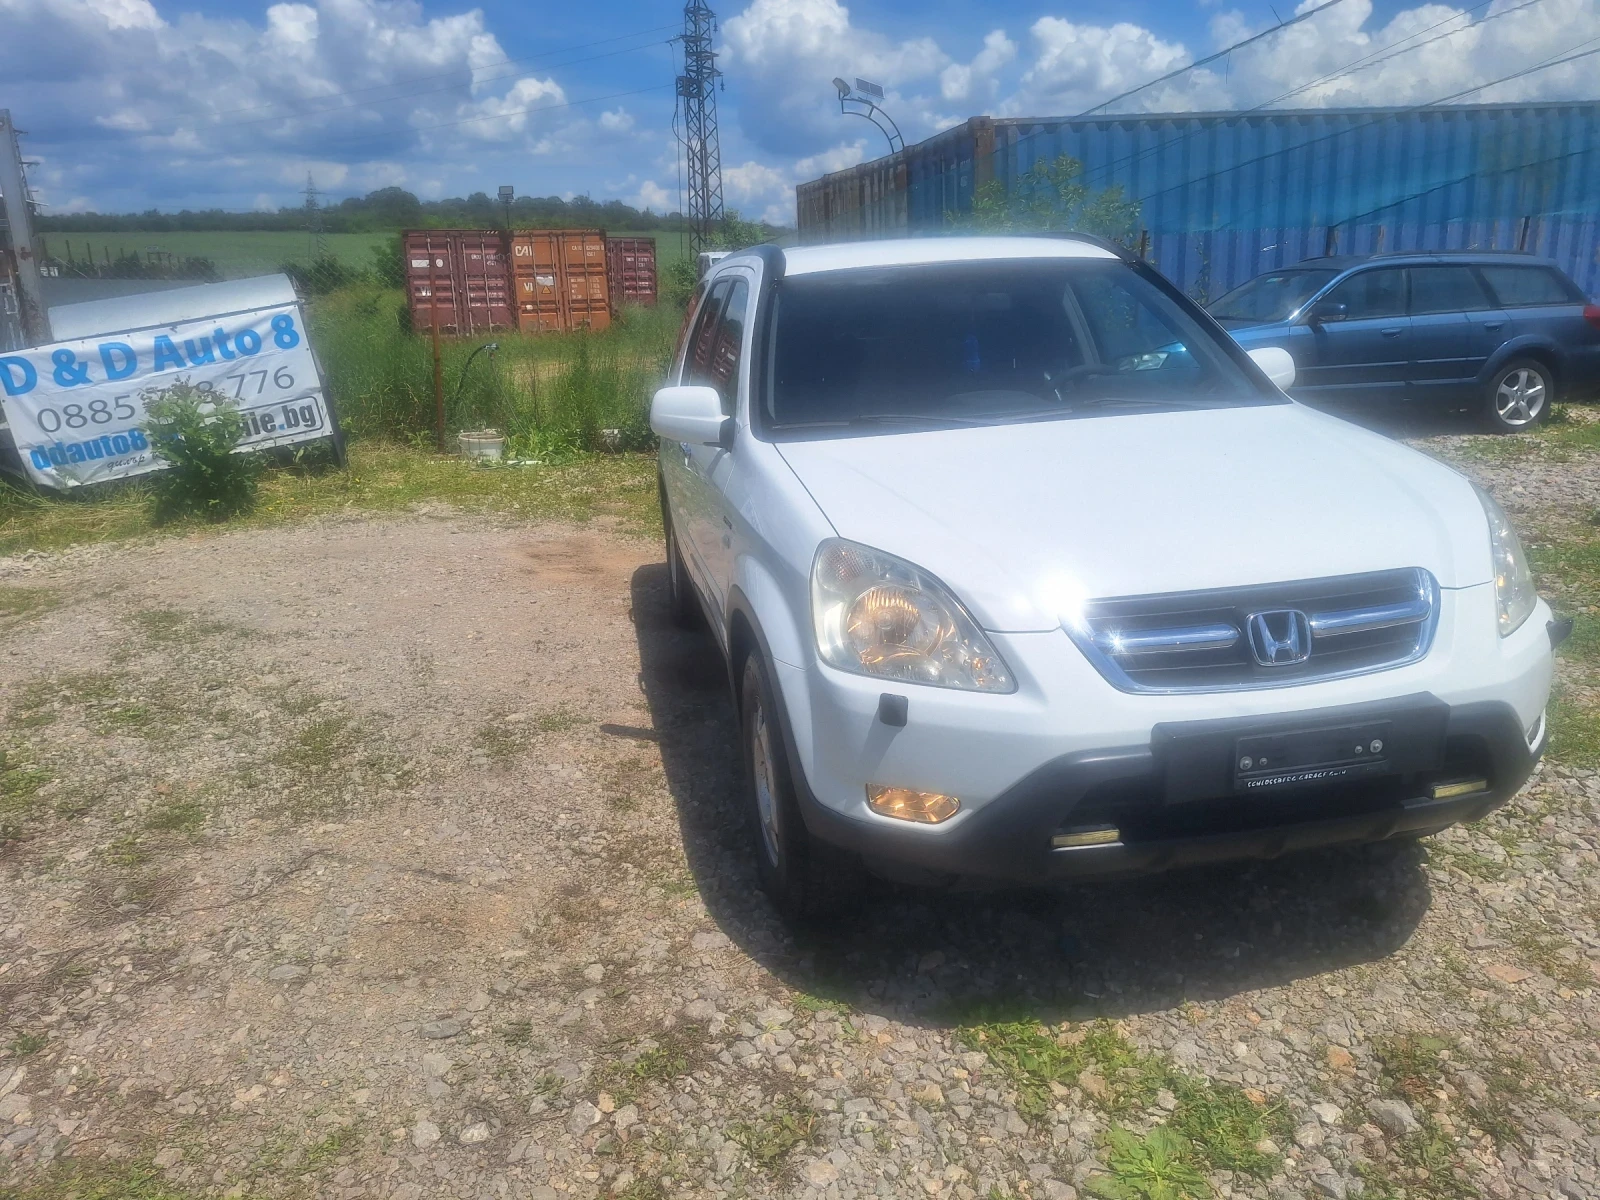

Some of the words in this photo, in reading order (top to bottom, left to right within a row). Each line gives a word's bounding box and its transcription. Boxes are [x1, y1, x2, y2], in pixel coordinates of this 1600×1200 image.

[0, 356, 38, 397] D
[52, 348, 92, 388] &
[99, 342, 138, 380] D
[153, 327, 262, 372] Auto
[270, 314, 300, 350] 8
[37, 394, 136, 433] 0885
[226, 365, 295, 399] 776
